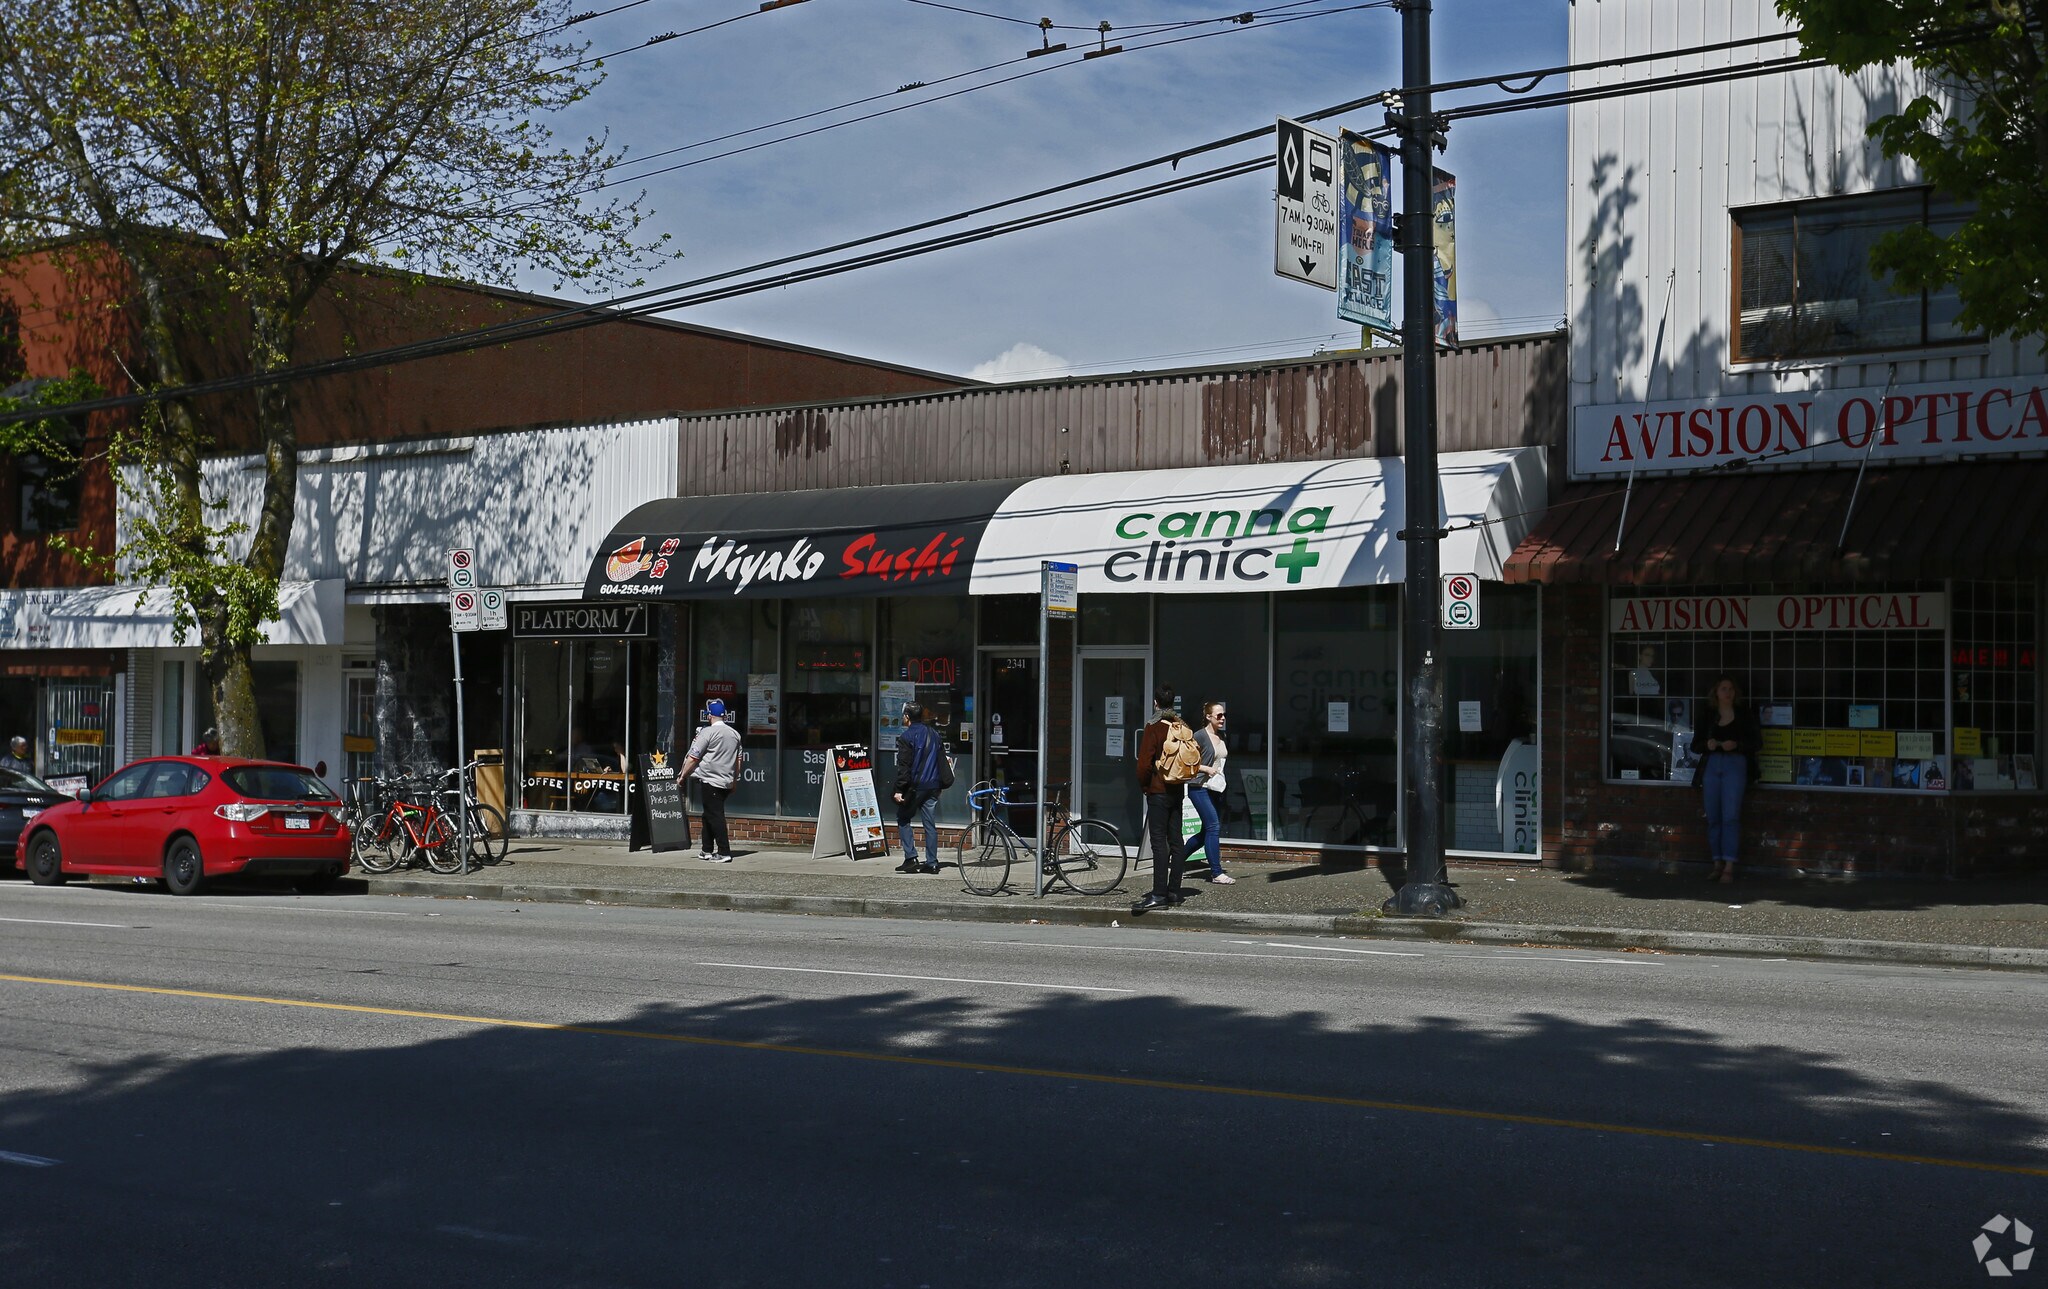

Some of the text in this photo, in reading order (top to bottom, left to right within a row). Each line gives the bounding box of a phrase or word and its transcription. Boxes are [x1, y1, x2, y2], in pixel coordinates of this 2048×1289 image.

[1291, 233, 1324, 255] MON-FRI
[1601, 402, 1813, 462] AVISION
[1115, 506, 1334, 540] canna
[688, 532, 965, 595] Miyako Sushi
[1103, 539, 1273, 582] clinic
[600, 584, 664, 595] 604-255-9411
[27, 594, 51, 605] EXCEL
[520, 606, 638, 632] PLATFORM 7
[1621, 595, 1930, 631] AVISION OPTICAL
[907, 657, 955, 684] OPEN
[1007, 658, 1025, 669] 2341
[706, 684, 732, 692] JUST EAT
[848, 750, 867, 759] Miyako
[647, 768, 674, 777] SAPPORO
[847, 759, 871, 769] Sushi
[744, 768, 765, 782] Out
[520, 777, 563, 790] COFFEE
[575, 779, 620, 792] COFFEE
[1515, 771, 1531, 844] clinic
